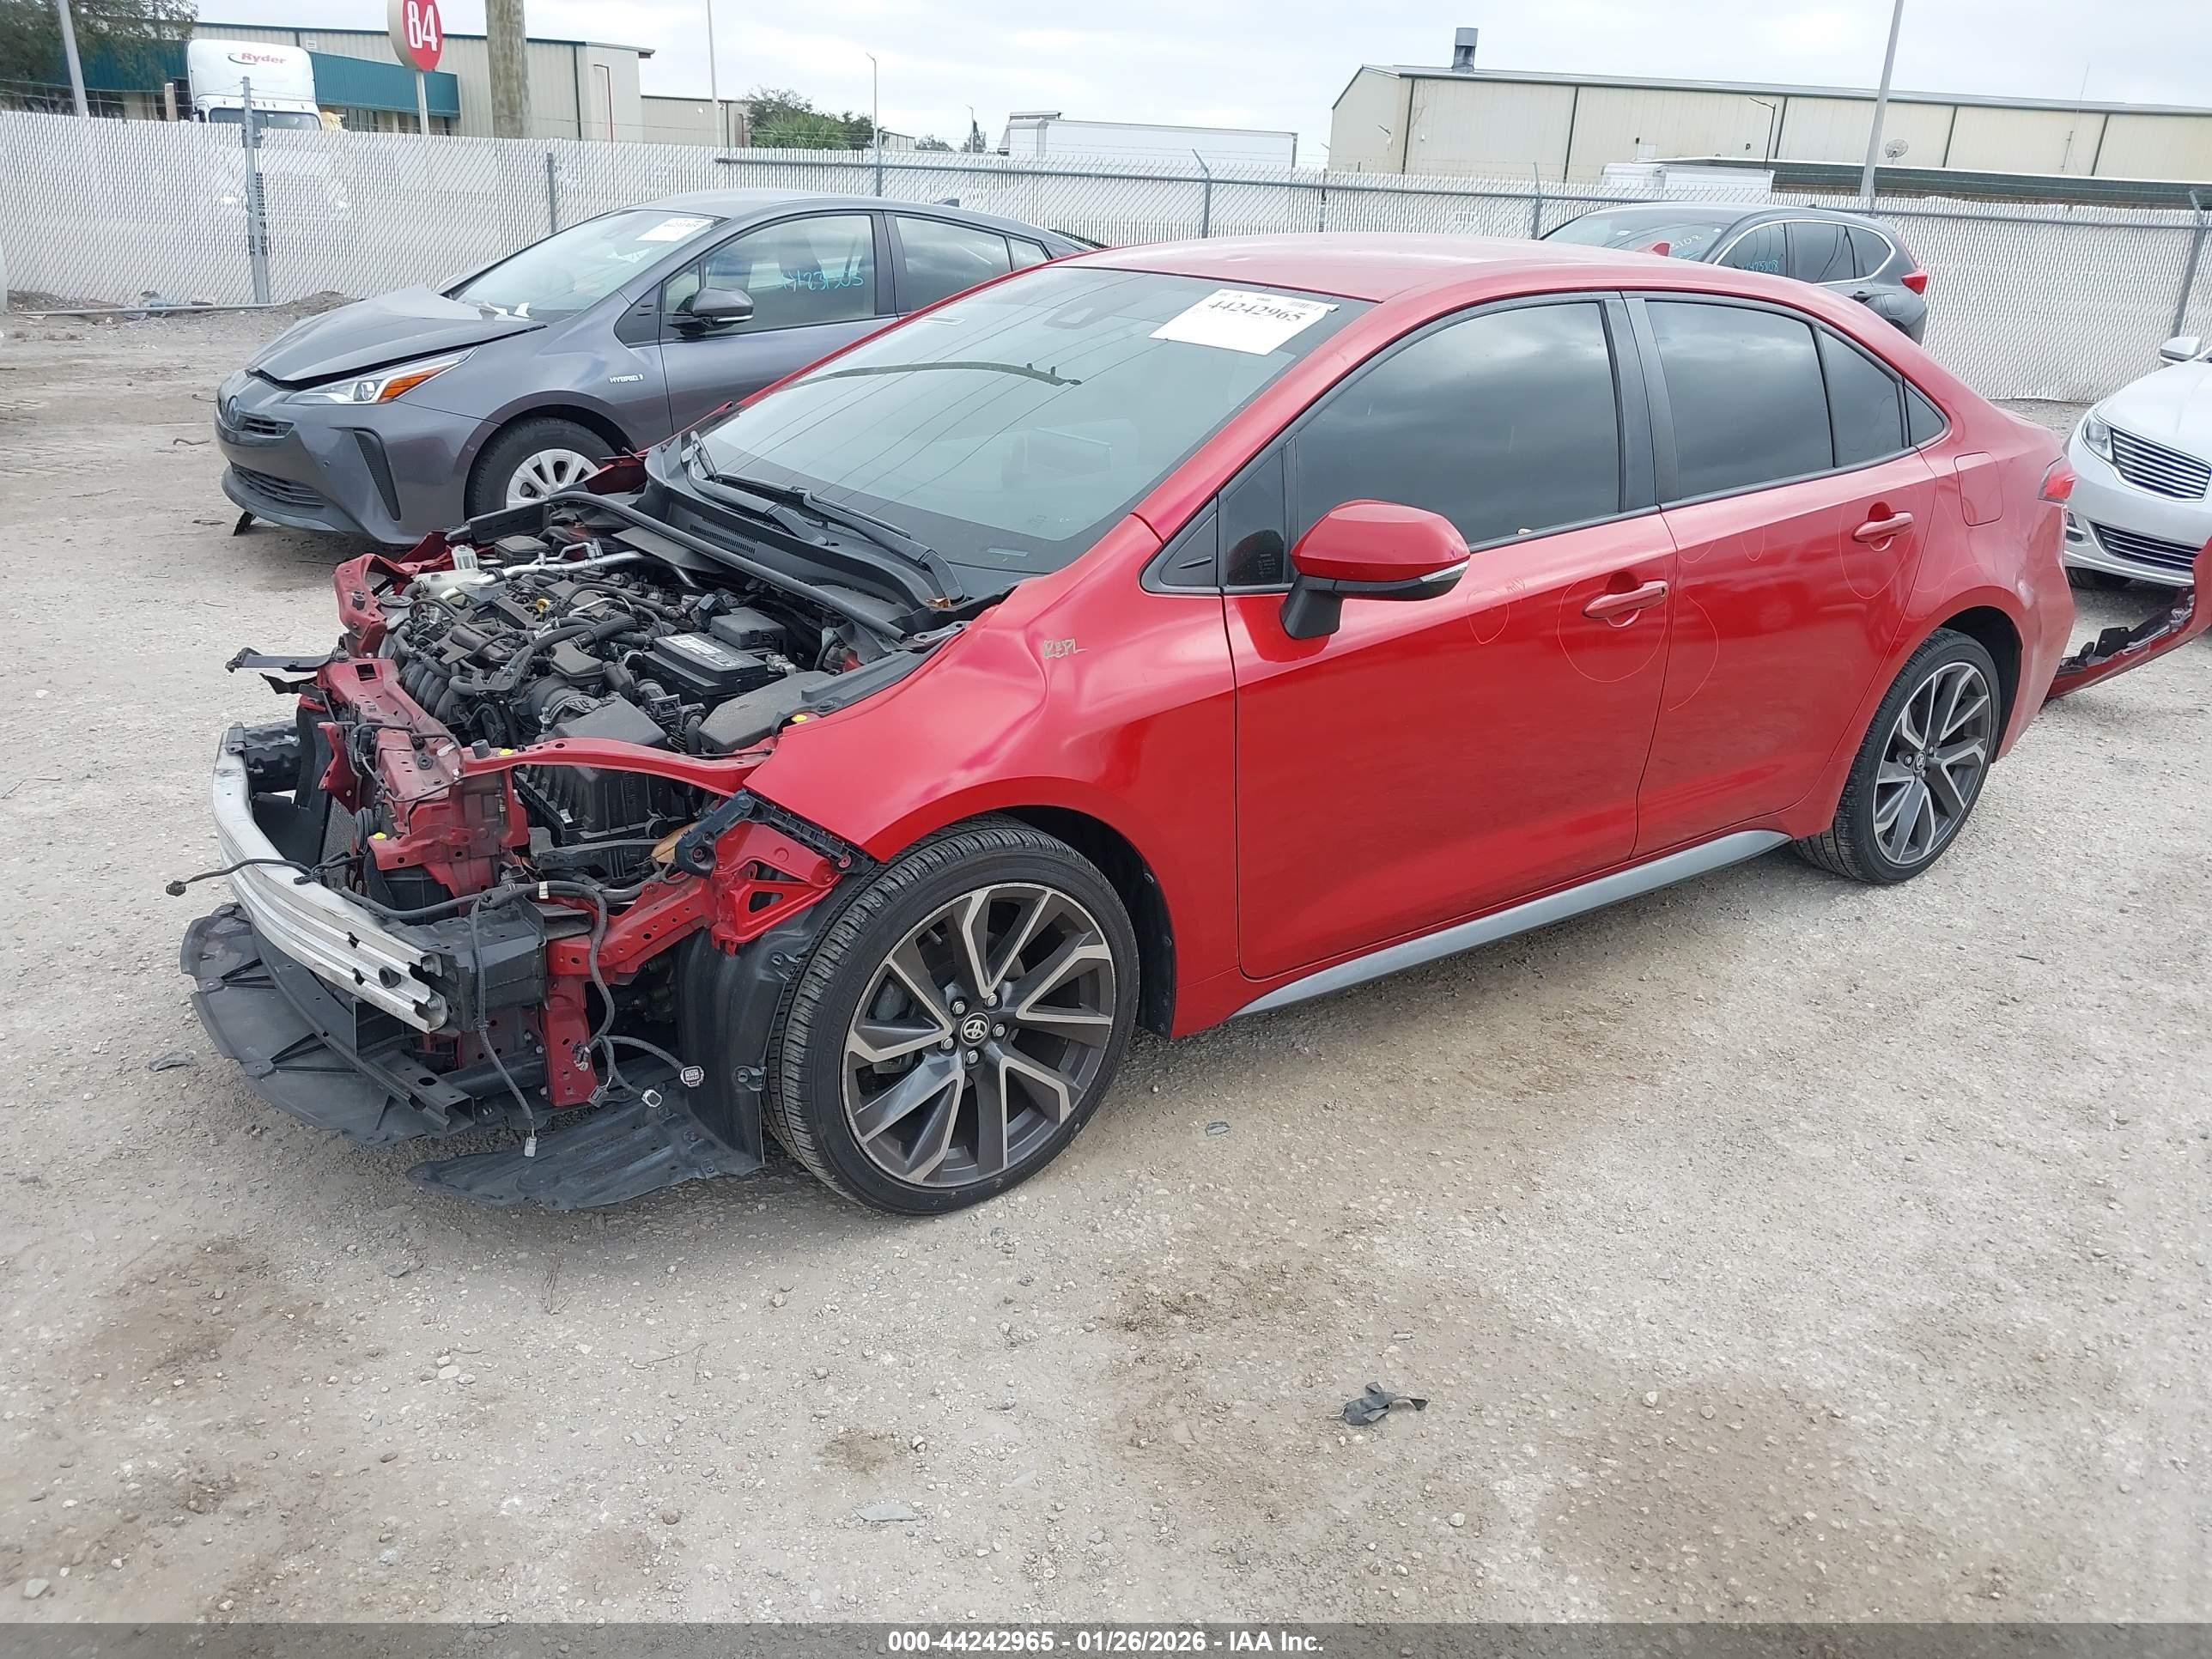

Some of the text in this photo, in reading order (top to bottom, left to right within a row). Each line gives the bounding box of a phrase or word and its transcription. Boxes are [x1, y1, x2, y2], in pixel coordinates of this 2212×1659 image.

[407, 1, 438, 52] 84
[241, 52, 287, 64] Ryder
[1208, 301, 1306, 321] 44242965
[609, 374, 640, 384] HYBRID
